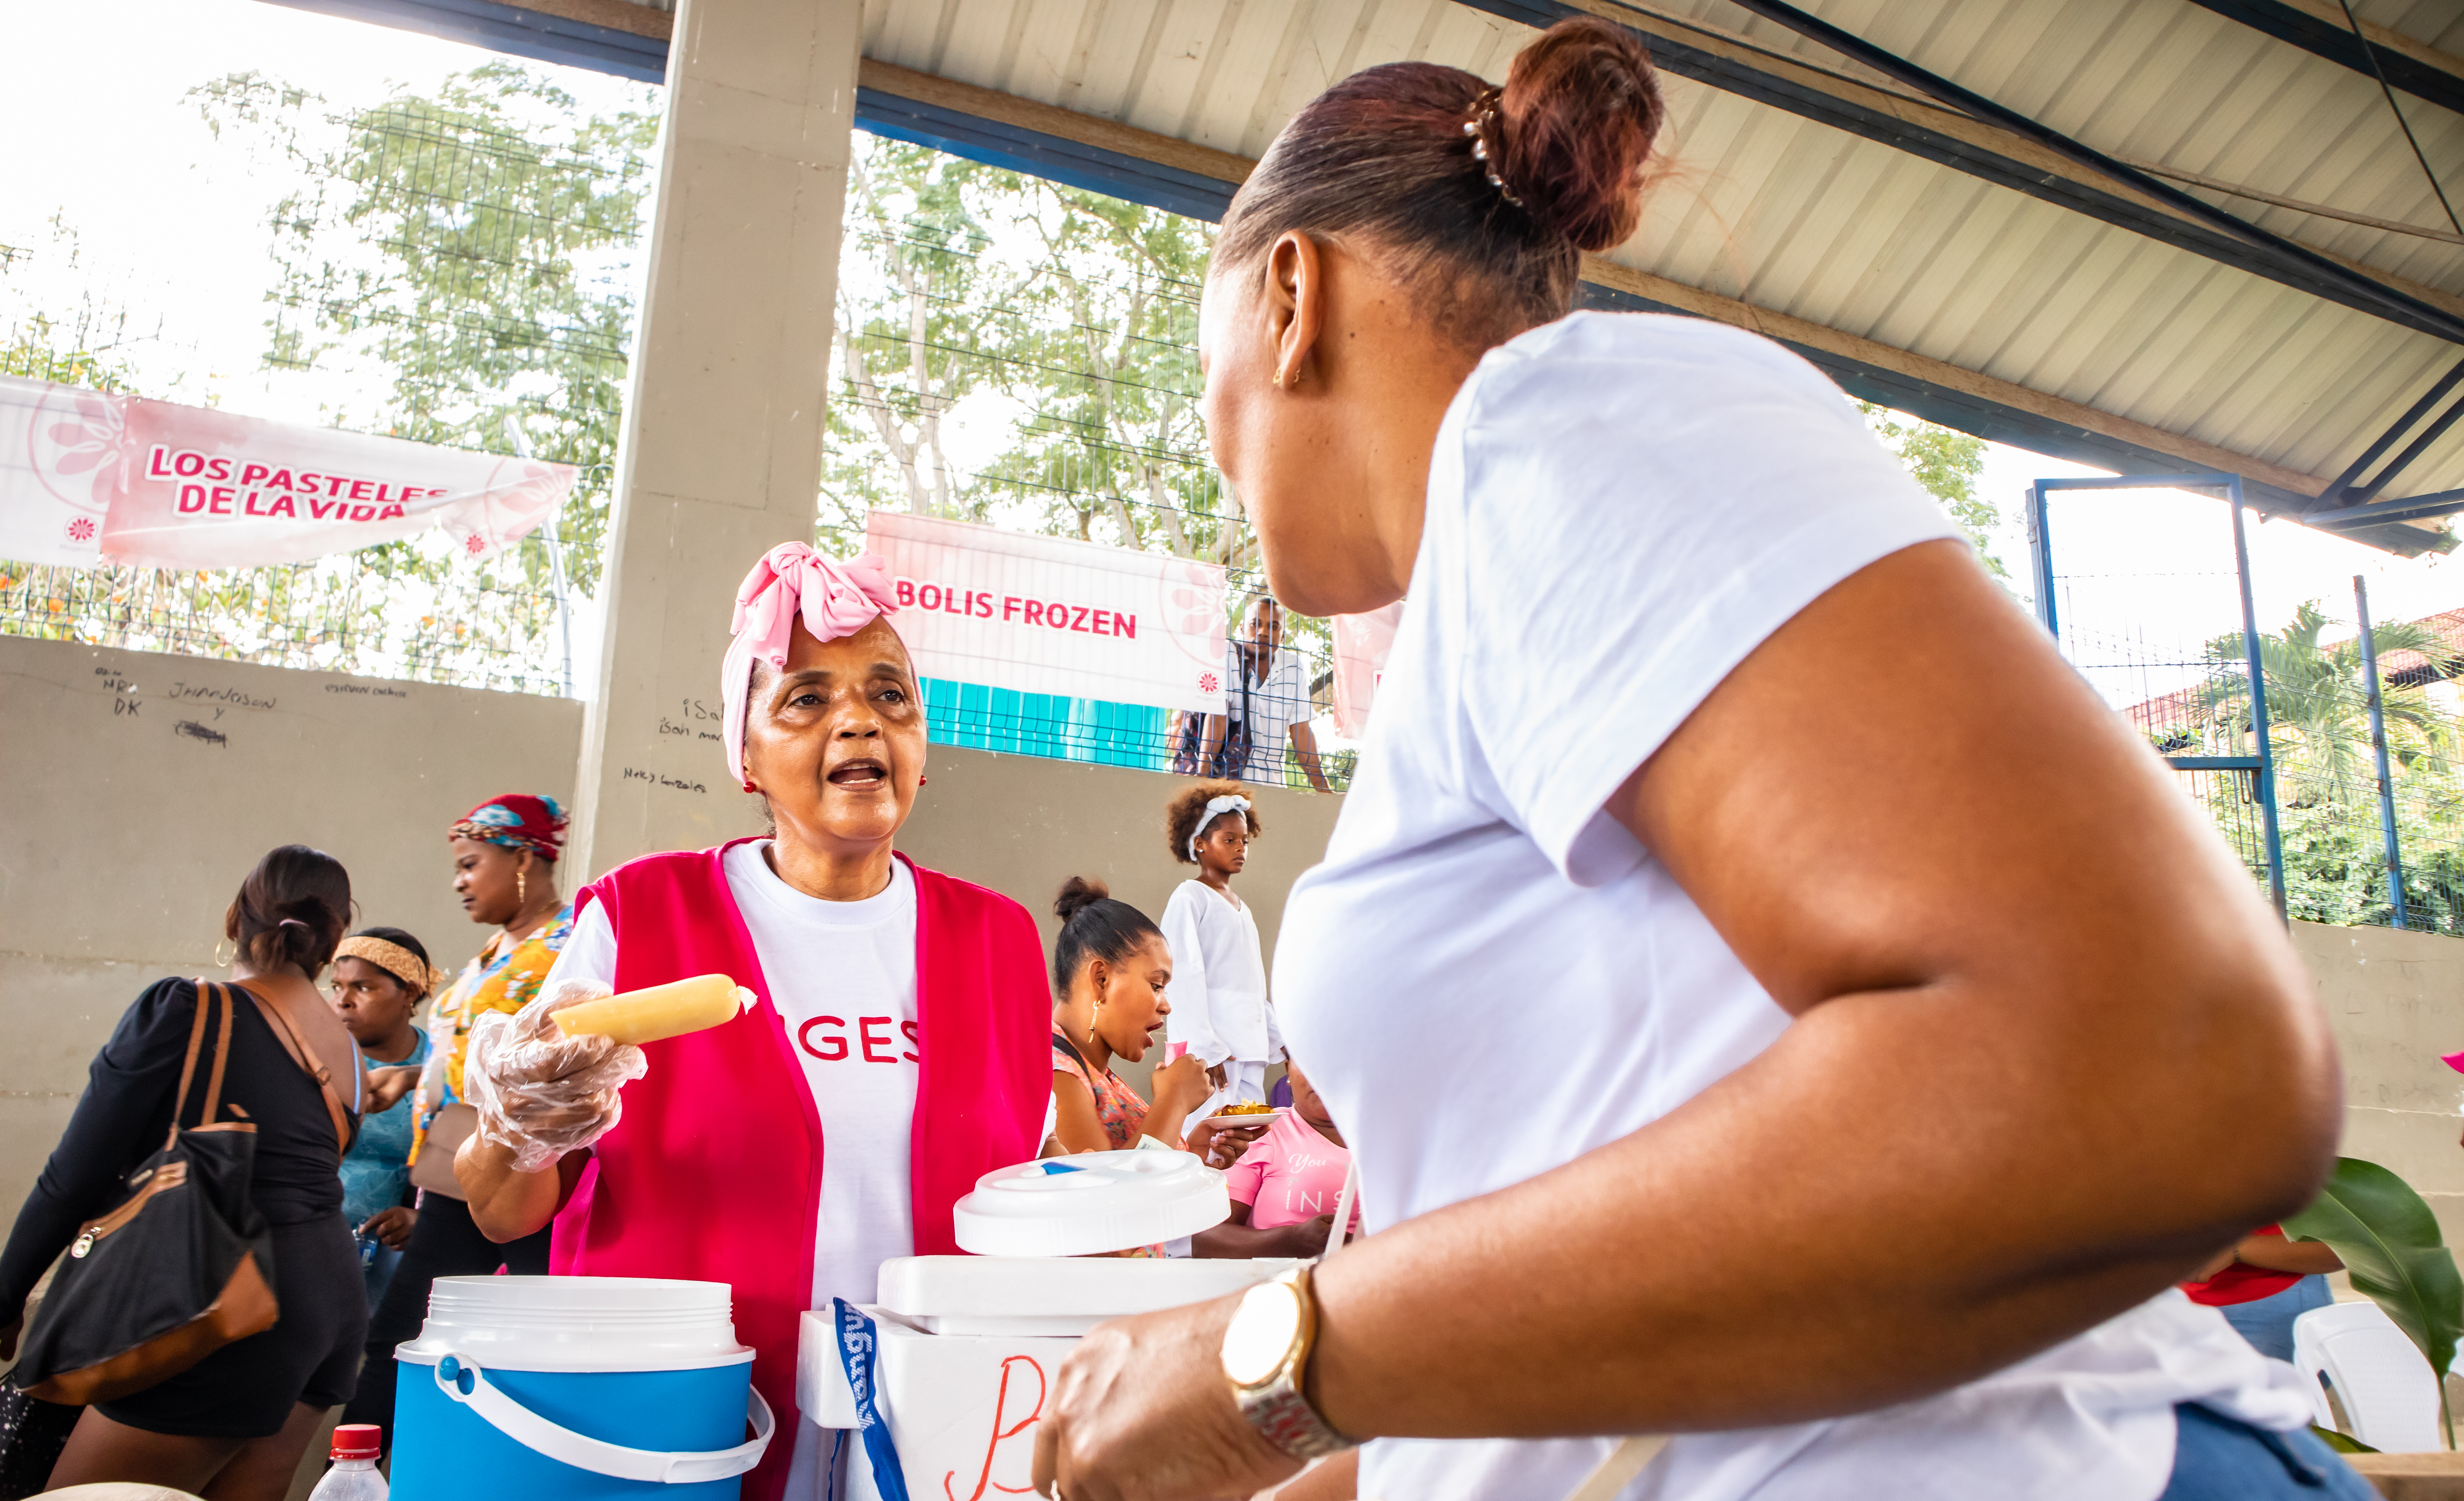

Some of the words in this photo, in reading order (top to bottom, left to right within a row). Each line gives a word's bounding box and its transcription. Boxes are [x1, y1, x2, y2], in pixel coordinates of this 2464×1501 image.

[151, 448, 231, 480] LOS
[178, 485, 235, 514] DE
[245, 492, 296, 517] LA
[309, 499, 405, 522] VIDA
[897, 581, 993, 618] BOLIS
[1003, 596, 1136, 639] FROZEN
[114, 697, 142, 716] DK
[777, 1014, 919, 1064] GES
[1289, 1153, 1326, 1174] You
